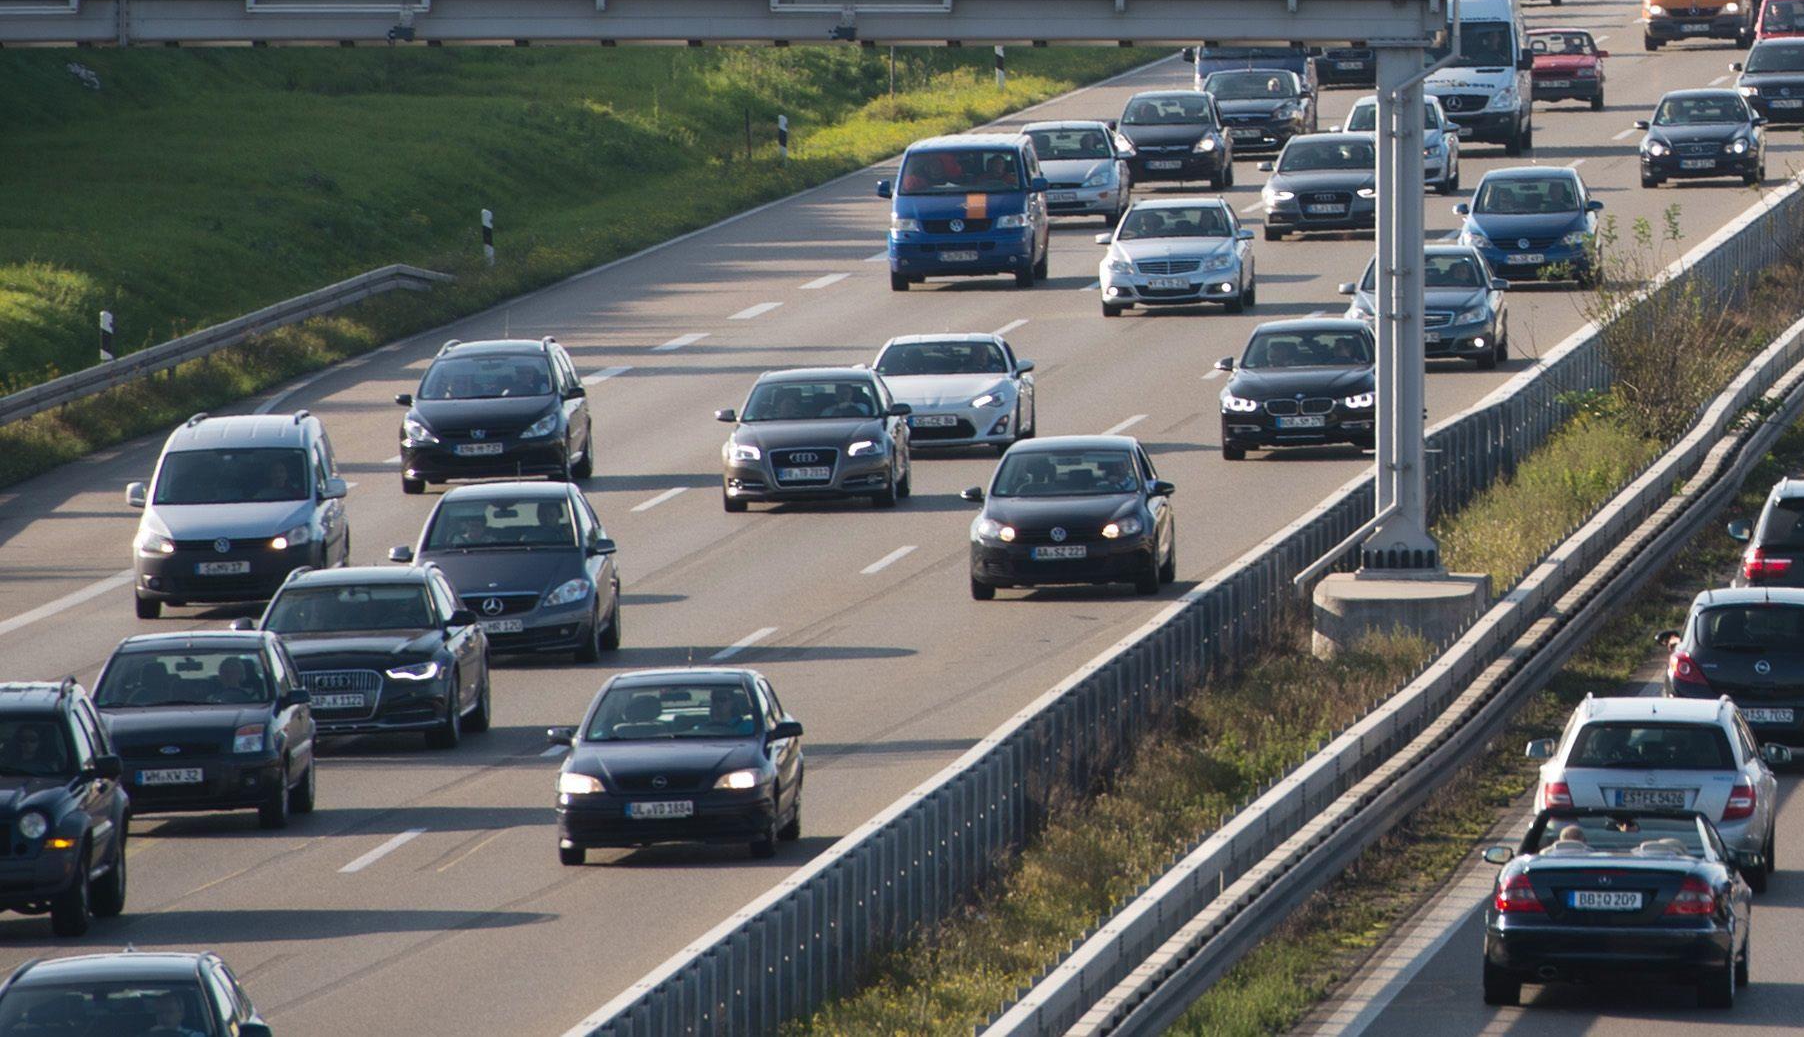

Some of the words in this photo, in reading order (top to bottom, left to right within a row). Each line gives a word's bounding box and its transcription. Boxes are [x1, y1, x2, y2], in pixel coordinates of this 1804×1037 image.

[1579, 894, 1595, 906] BB
[1603, 894, 1612, 907] Q
[1614, 893, 1637, 906] 209
